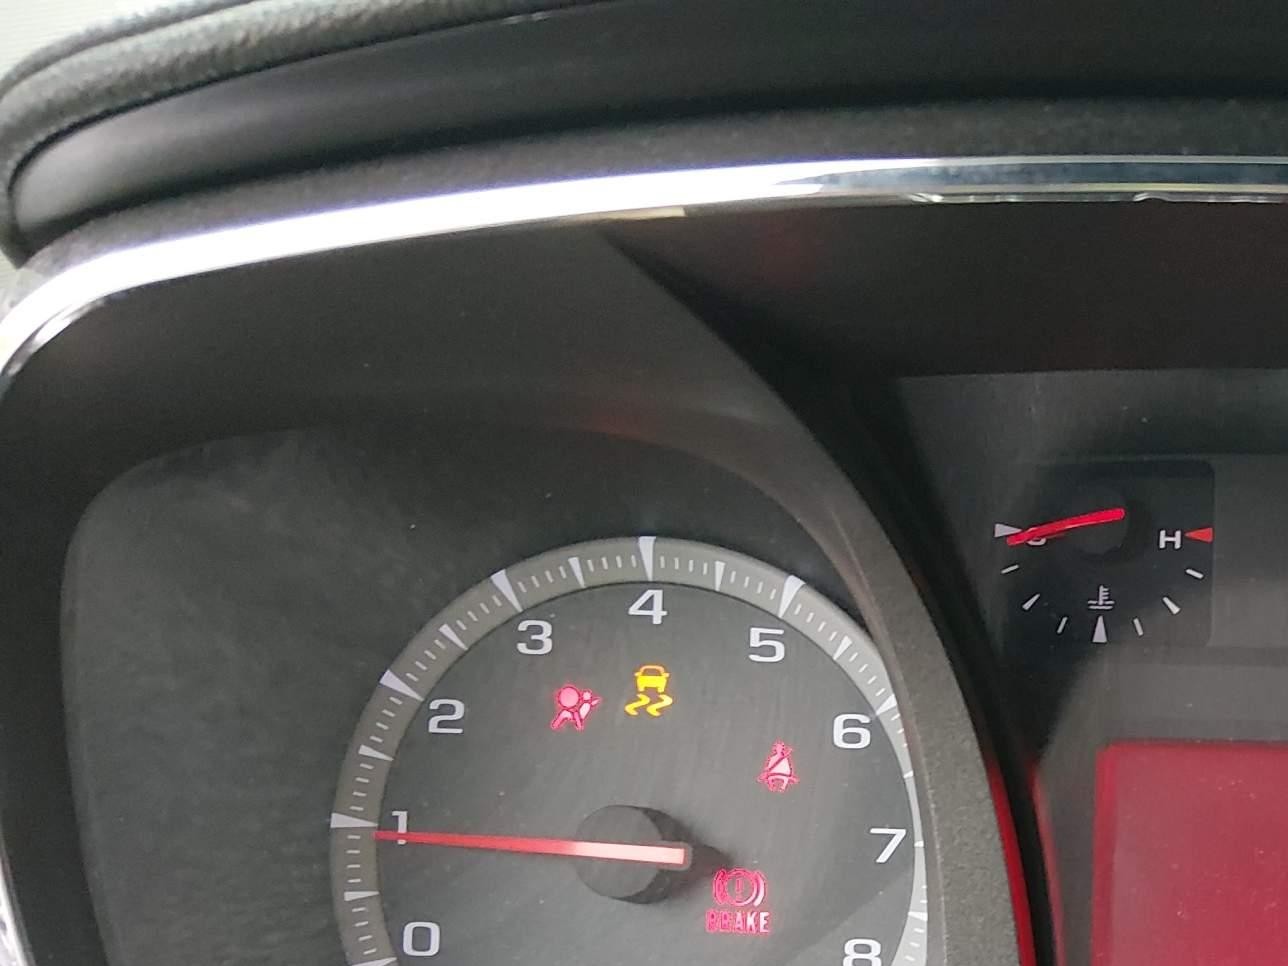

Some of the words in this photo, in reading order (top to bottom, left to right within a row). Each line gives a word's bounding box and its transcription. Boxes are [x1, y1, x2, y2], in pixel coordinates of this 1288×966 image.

[1158, 528, 1182, 550] H
[628, 589, 667, 625] 4
[516, 619, 553, 656] 3
[748, 627, 786, 663] 5
[428, 698, 465, 735] 2
[831, 713, 872, 750] 6
[390, 810, 409, 846] 1
[868, 827, 907, 864] 7
[402, 921, 441, 957] 0
[706, 911, 769, 934] BRAKE
